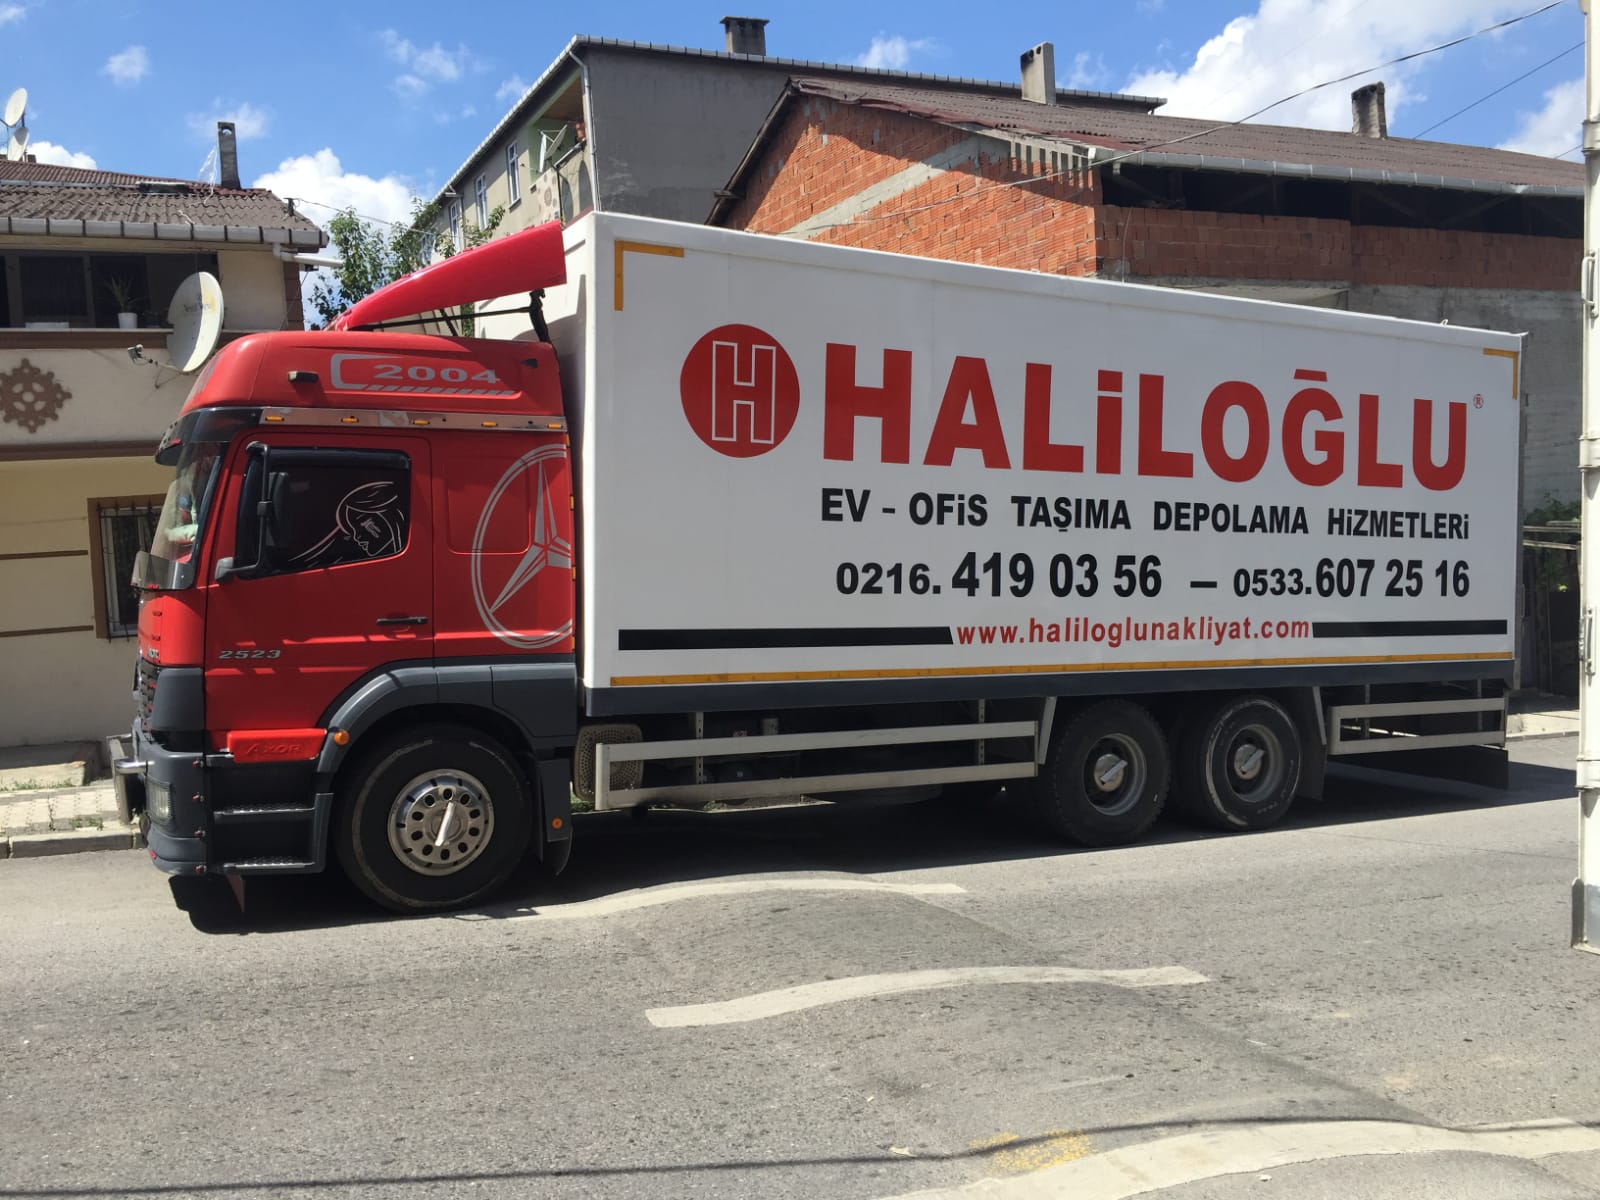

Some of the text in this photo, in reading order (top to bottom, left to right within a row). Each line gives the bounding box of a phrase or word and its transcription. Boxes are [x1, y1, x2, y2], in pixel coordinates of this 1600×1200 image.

[373, 364, 500, 384] 2004
[821, 487, 871, 523] EV
[1010, 495, 1132, 533] TAŞIMA
[1153, 500, 1309, 535] DEPOLAMA
[1049, 553, 1099, 598] 03
[1113, 554, 1162, 598] 56
[1384, 558, 1424, 598] 25
[1435, 559, 1470, 598] 16
[956, 617, 1310, 649] www.haliloglunakliyat.com
[218, 650, 282, 660] 2523
